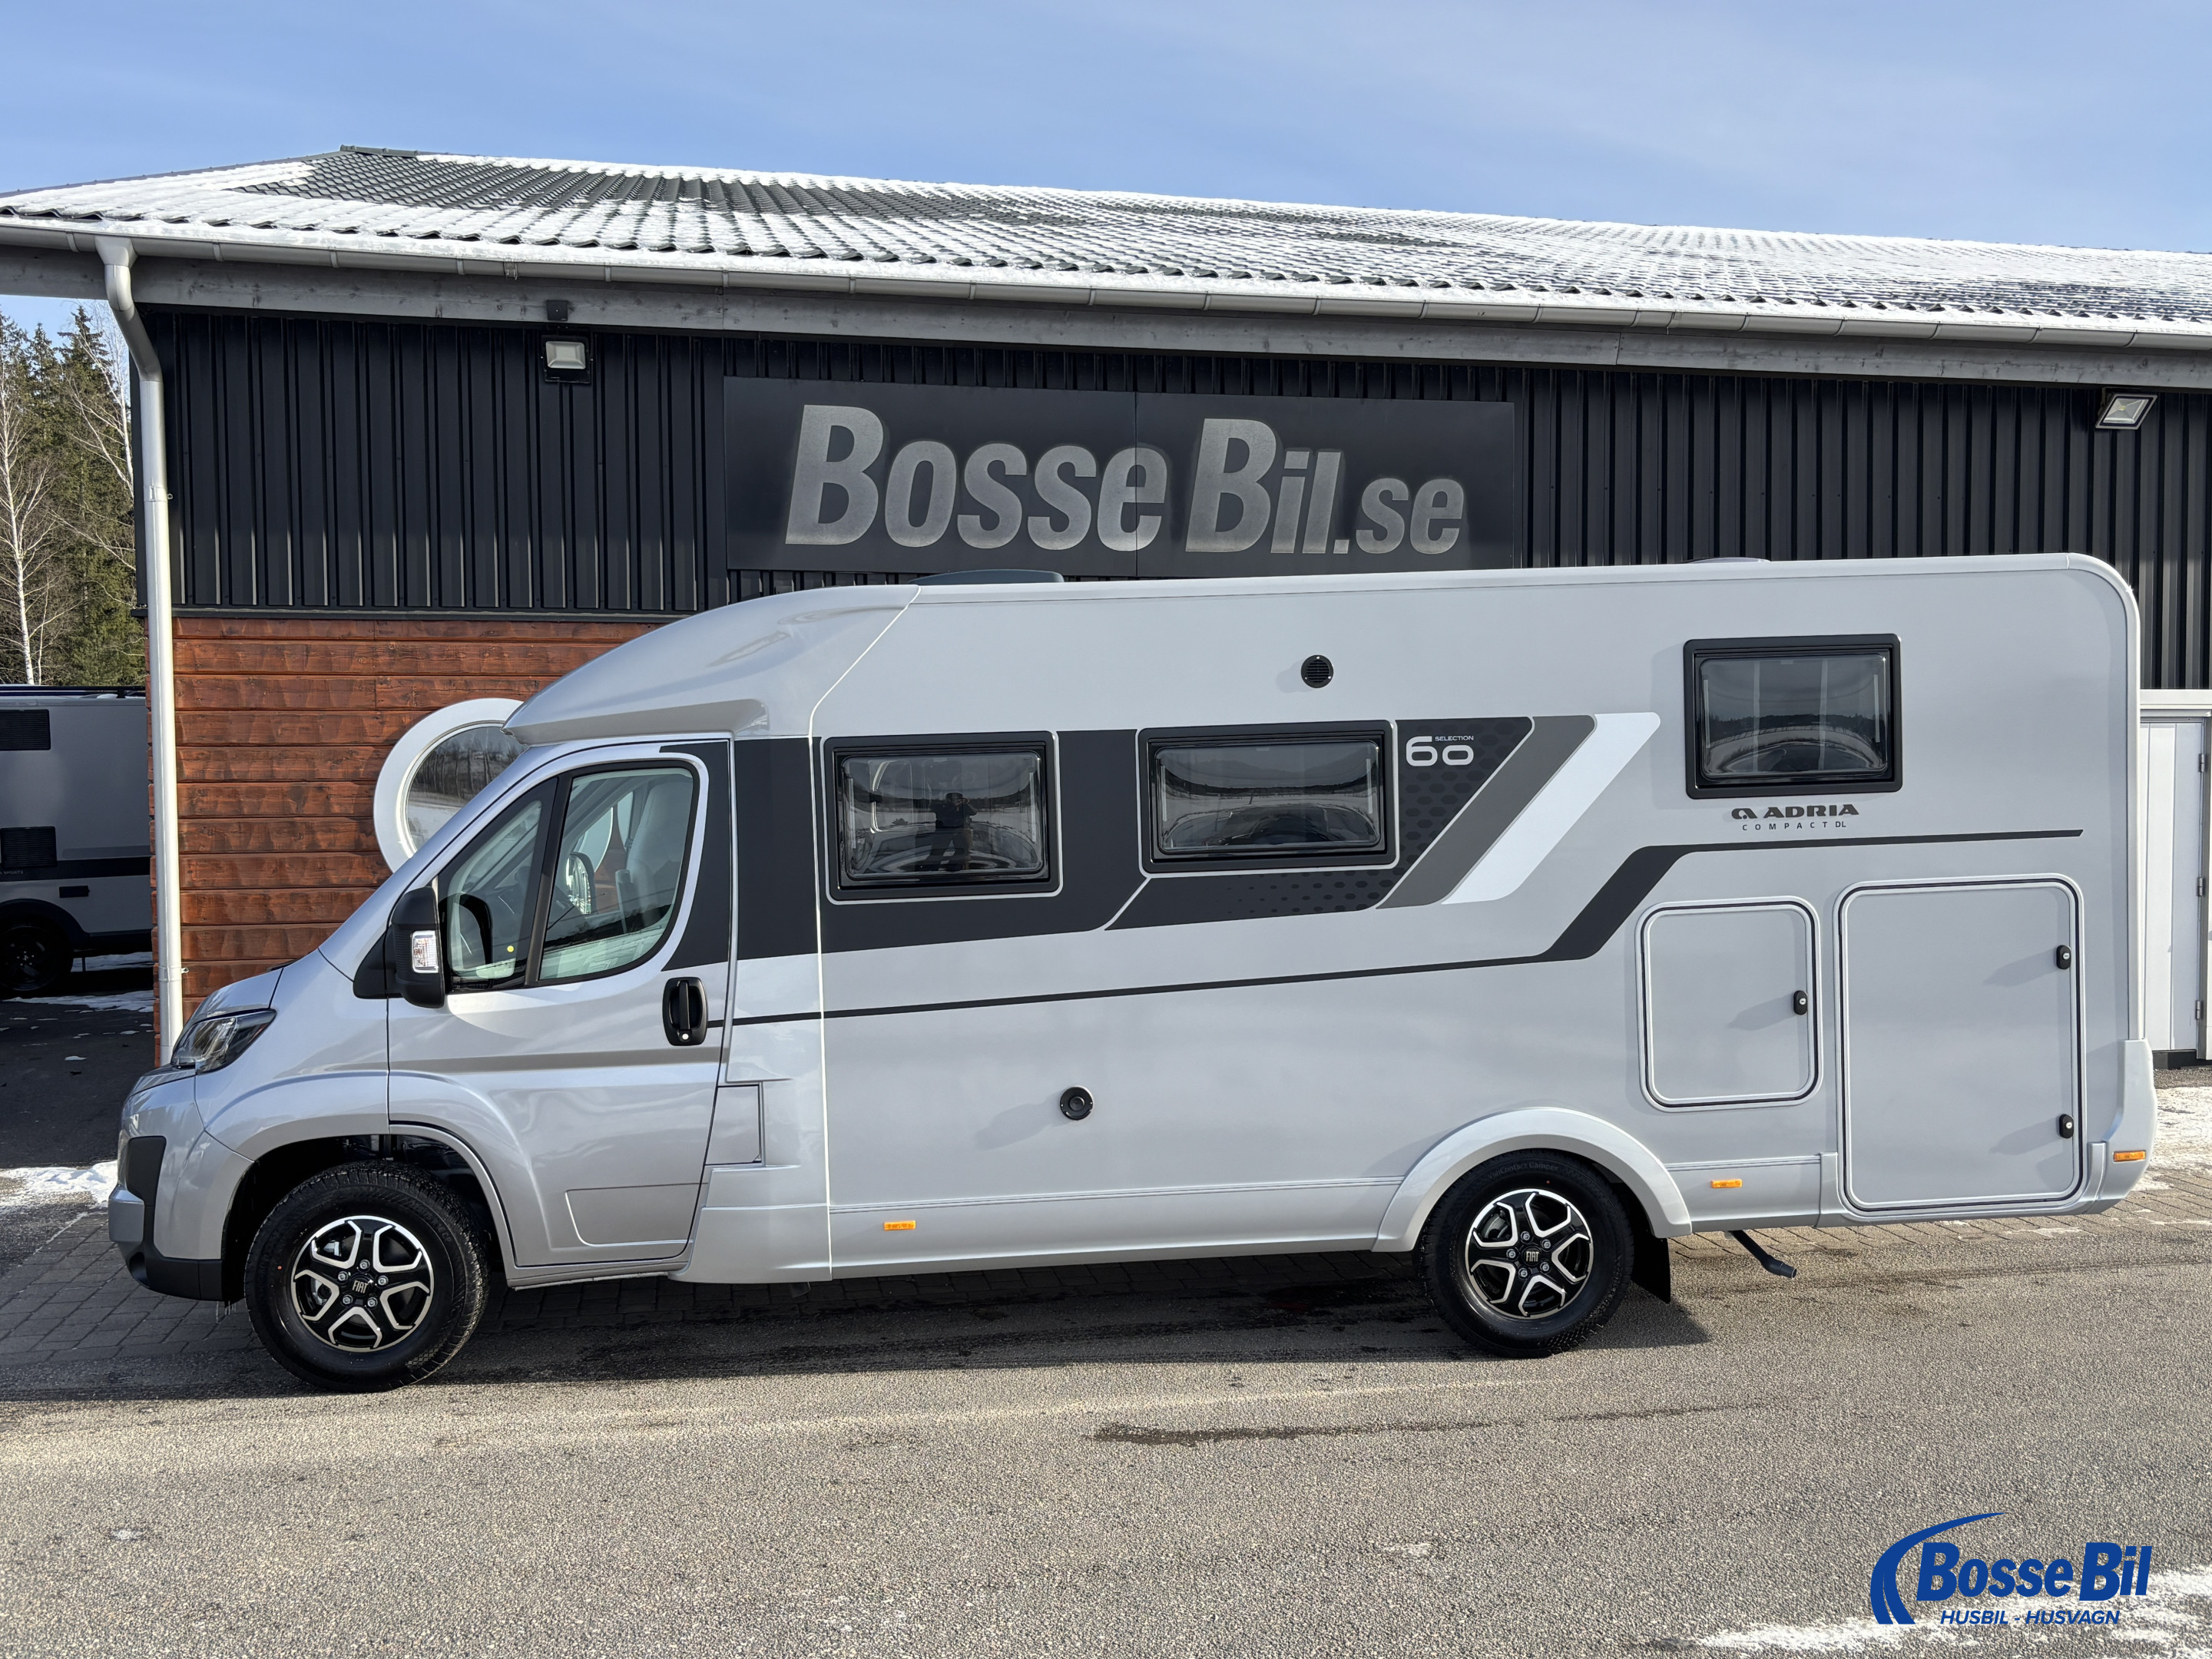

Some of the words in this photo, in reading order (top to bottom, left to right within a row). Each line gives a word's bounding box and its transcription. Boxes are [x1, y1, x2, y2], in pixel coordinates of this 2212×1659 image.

[786, 404, 1167, 551] Bosse
[1184, 418, 1465, 555] Bil.se
[1406, 736, 1474, 767] 60
[1763, 804, 1859, 819] ADRIA
[1742, 821, 1828, 831] COMPACT
[1525, 1251, 1539, 1262] FIAT
[352, 1280, 369, 1293] FIAT
